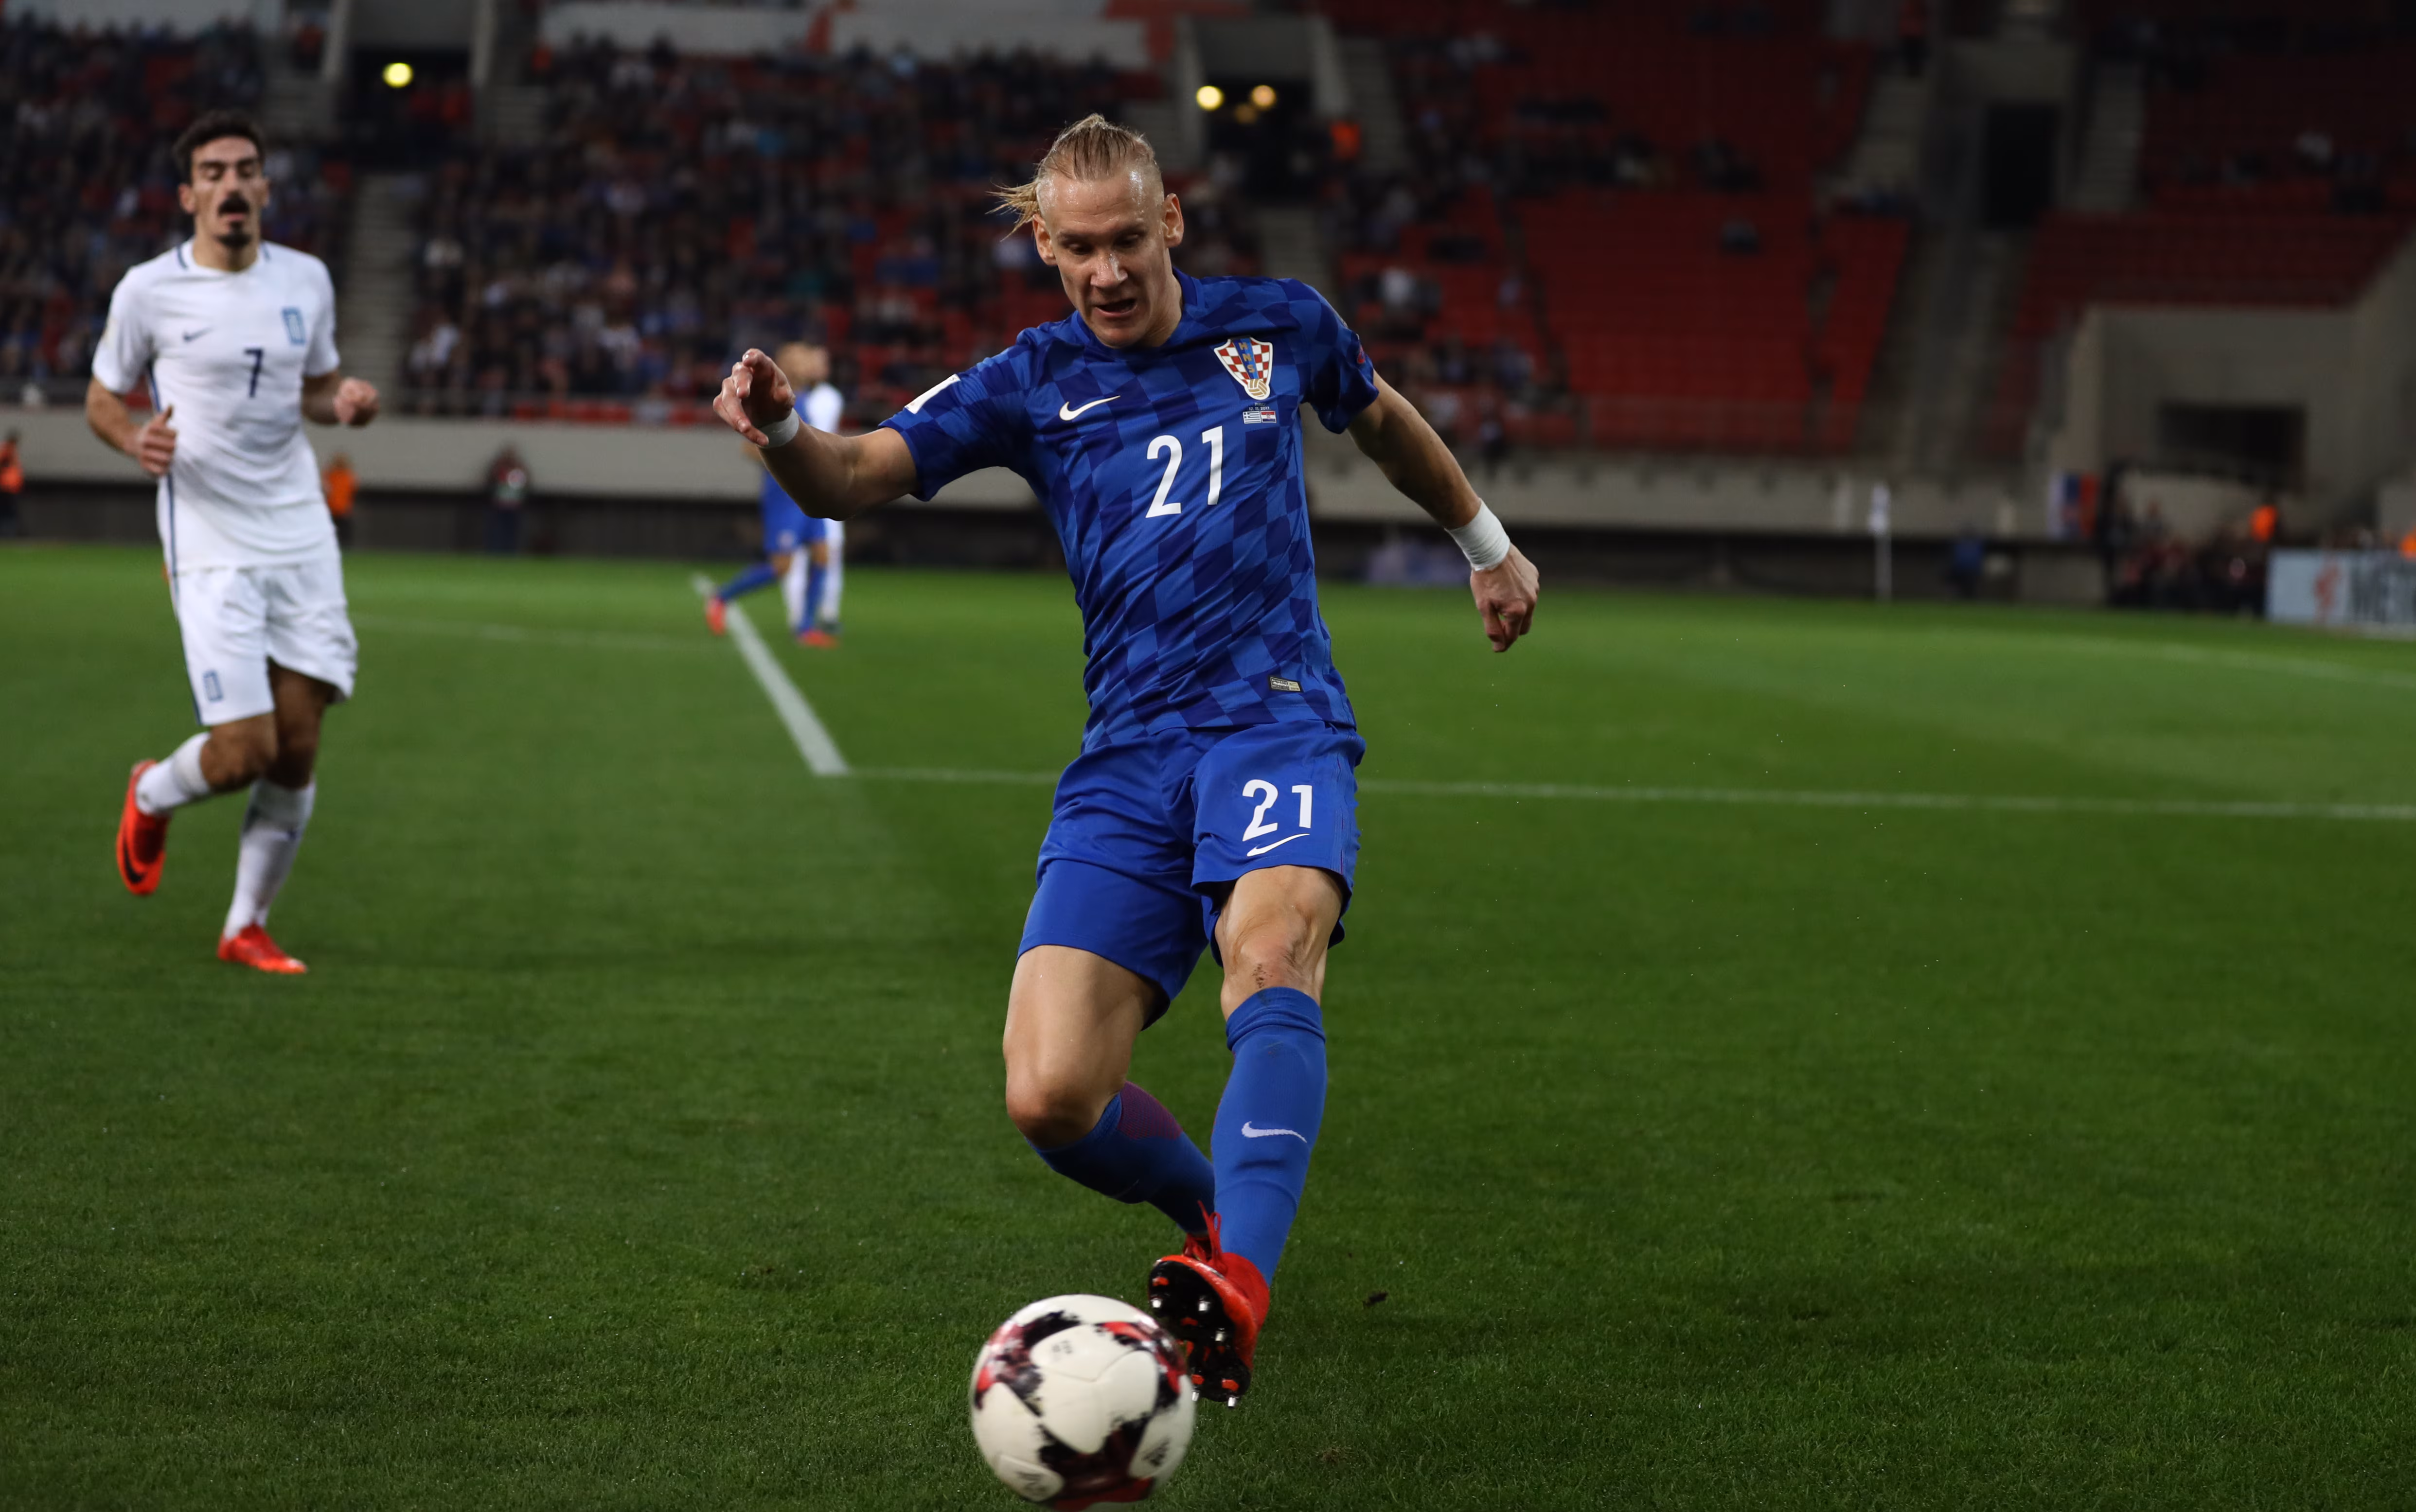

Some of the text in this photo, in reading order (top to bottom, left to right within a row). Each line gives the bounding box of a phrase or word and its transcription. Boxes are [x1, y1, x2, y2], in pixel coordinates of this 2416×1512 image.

[244, 348, 265, 398] 7
[1238, 342, 1255, 373] HNS
[1146, 426, 1223, 518] 21
[1243, 779, 1313, 842] 21
